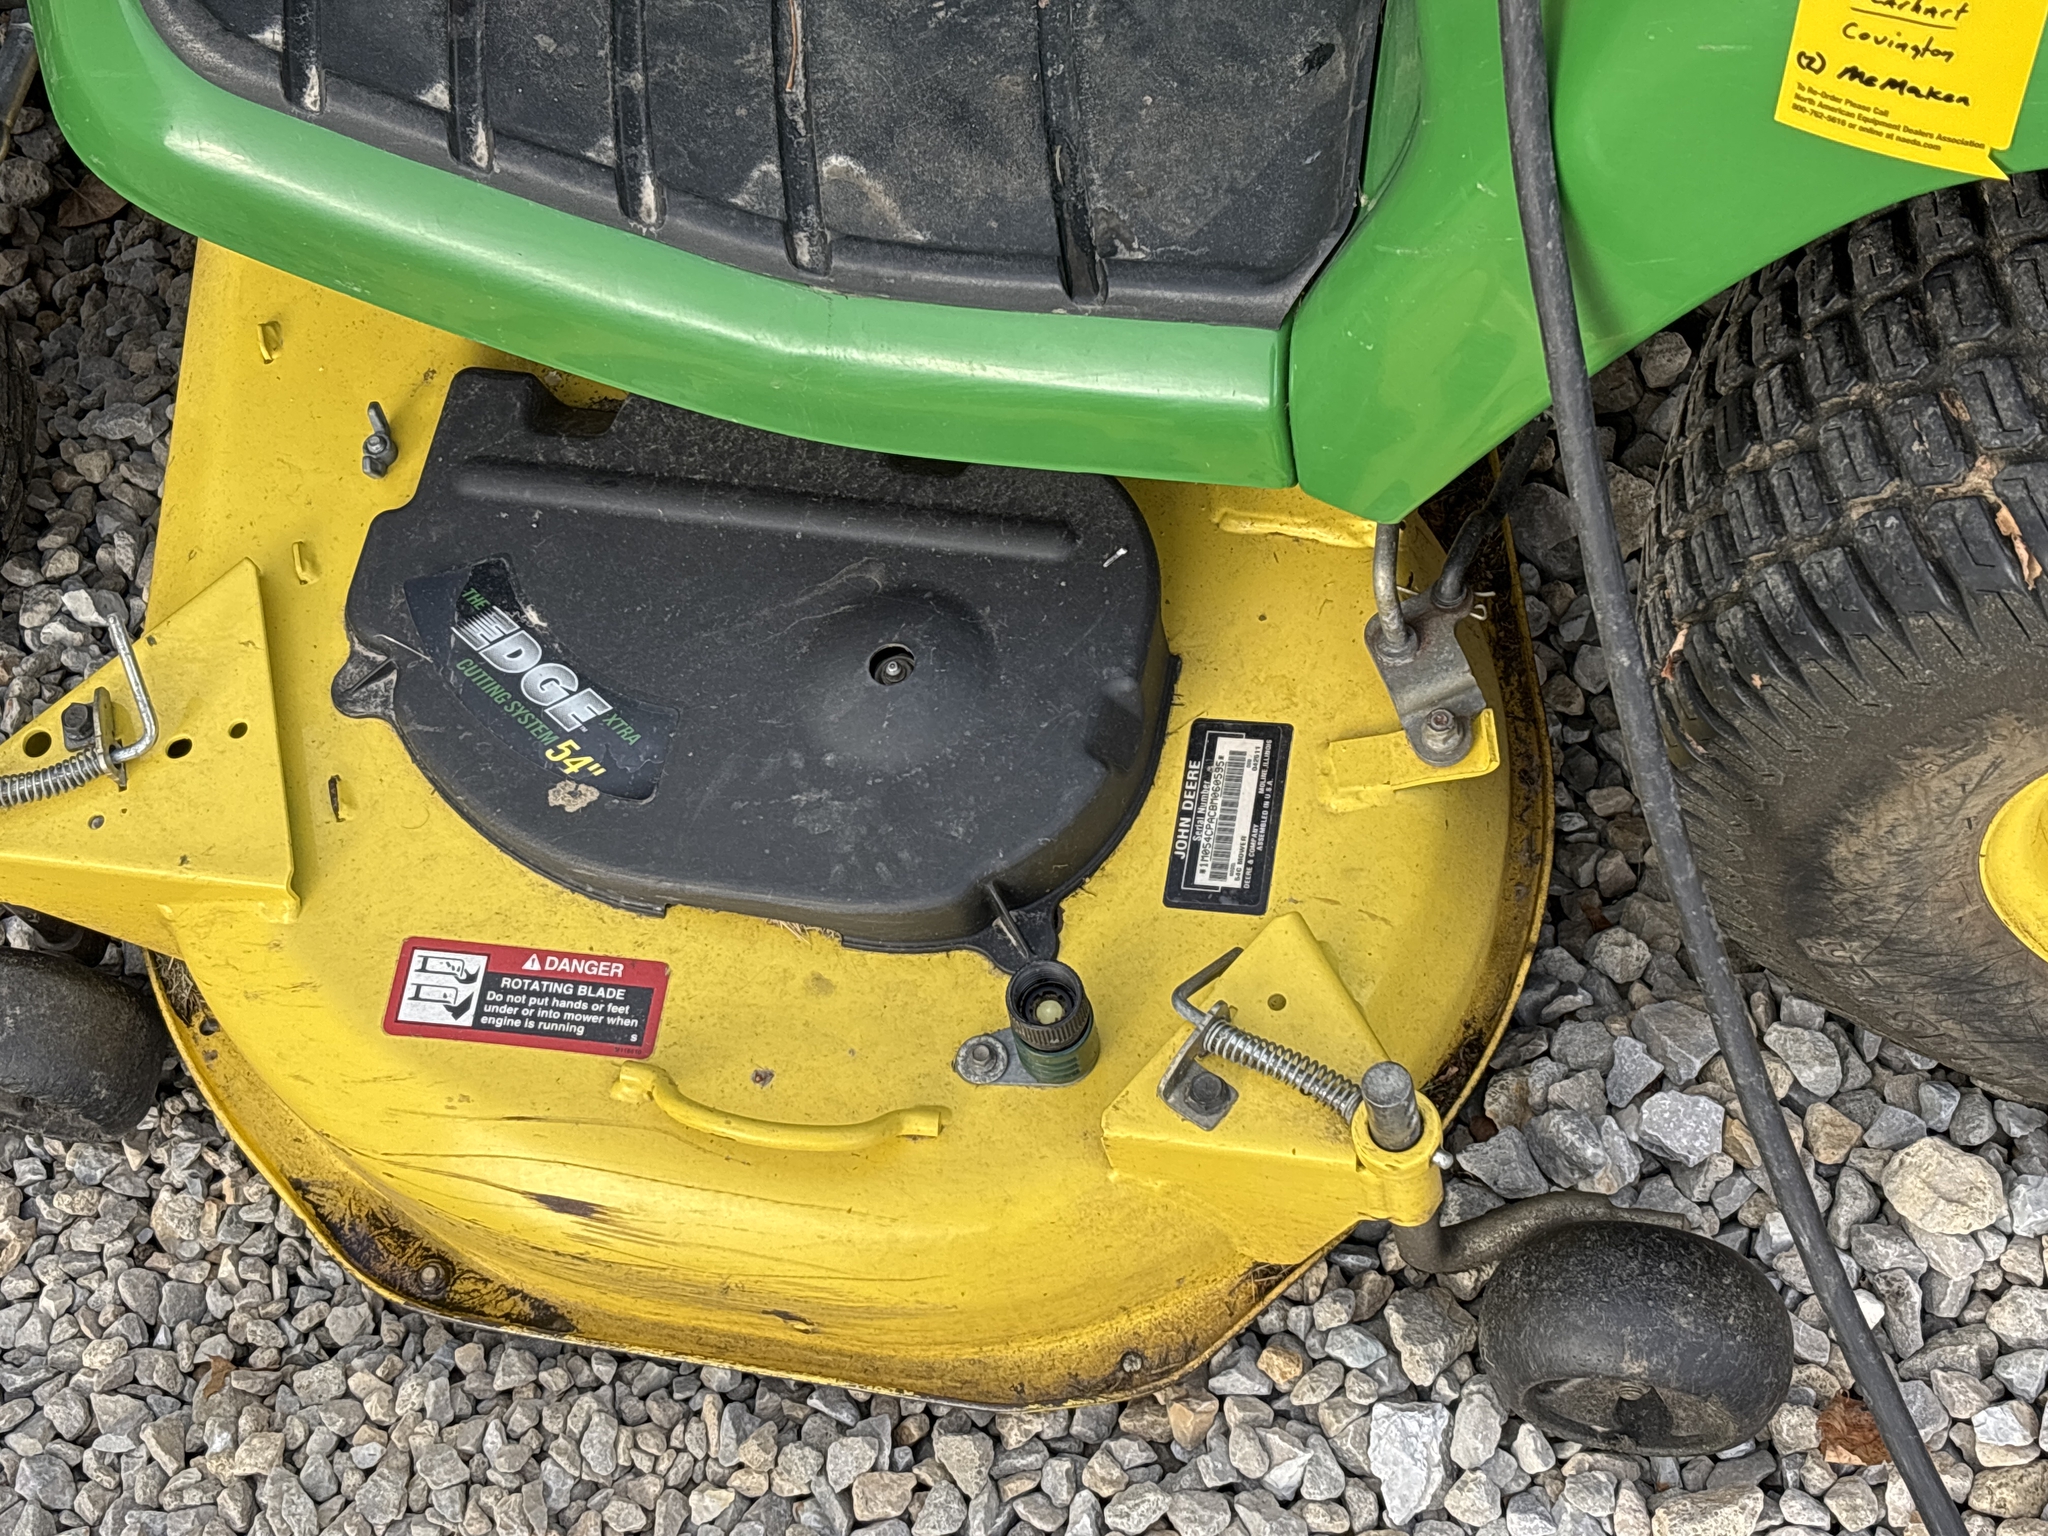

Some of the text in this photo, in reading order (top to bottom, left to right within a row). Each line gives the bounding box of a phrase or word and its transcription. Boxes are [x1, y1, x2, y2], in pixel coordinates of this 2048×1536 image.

[1871, 0, 1969, 21] arhart
[1842, 22, 1954, 63] Covington
[1797, 82, 1890, 118] To Re-Order Please Call
[1794, 92, 1985, 149] North American Equipment Dealers Association
[1848, 122, 1858, 130] or
[1858, 125, 1884, 137] online
[1885, 132, 1895, 140] at
[1895, 135, 1942, 151] naeda.com
[461, 588, 490, 611] THE
[451, 605, 614, 733] EDGE
[602, 713, 642, 746] XTRA
[455, 658, 560, 746] CUTTING SYSTEM
[544, 739, 607, 777] 54"
[1174, 760, 1201, 860] JOHN DEERE
[1193, 780, 1210, 842] Serial Number
[1257, 810, 1269, 851] ASSEMBLED
[1264, 801, 1270, 809] IN
[1236, 836, 1247, 866] MOWER
[1243, 865, 1254, 889] DEERE
[1249, 823, 1259, 858] COMPANY
[544, 956, 624, 978] DANGER
[486, 991, 630, 1015] Do not put hands or feet
[500, 977, 627, 1000] ROTATING BLADE
[480, 1015, 586, 1036] engine is running
[483, 1003, 639, 1027] under or into mower when
